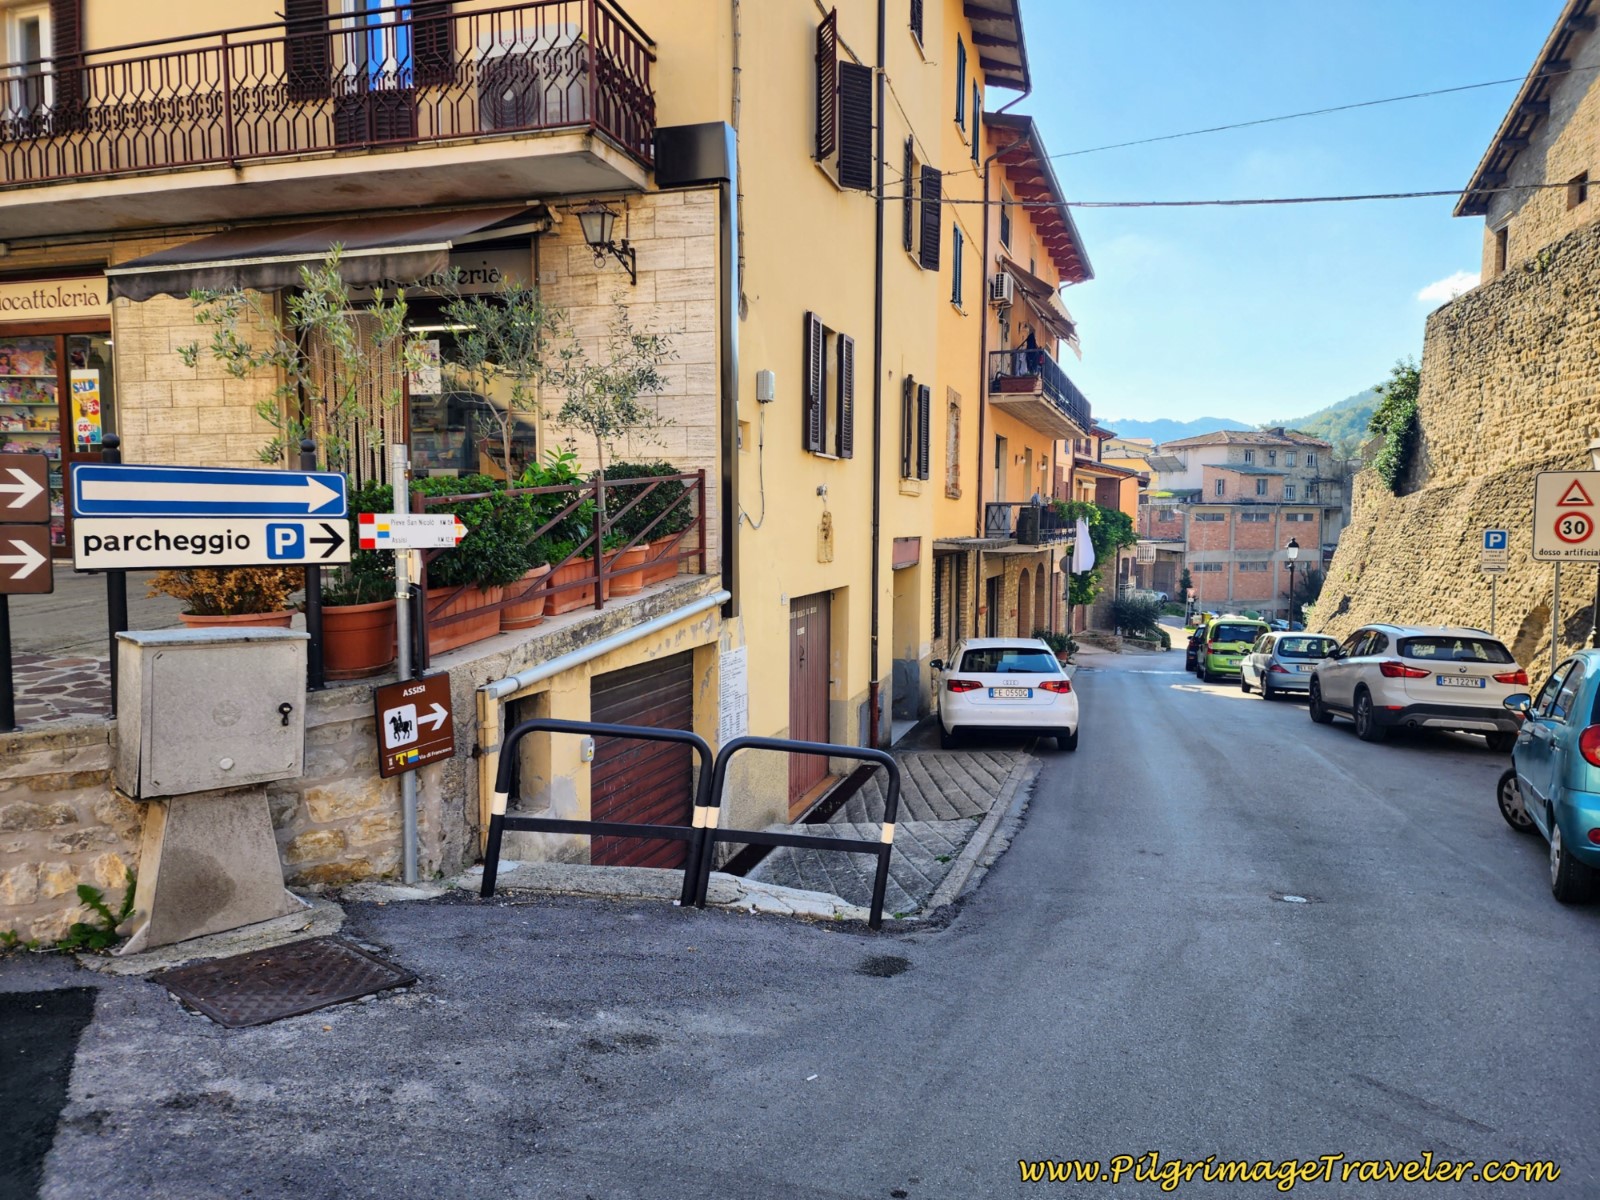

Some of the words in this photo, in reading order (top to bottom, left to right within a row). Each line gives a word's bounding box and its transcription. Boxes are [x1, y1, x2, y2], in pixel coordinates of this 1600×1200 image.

[1563, 520, 1585, 535] 30
[84, 529, 250, 556] parcheggio
[1489, 533, 1502, 547] P
[1539, 548, 1561, 556] dosso
[402, 685, 426, 697] ASSISI
